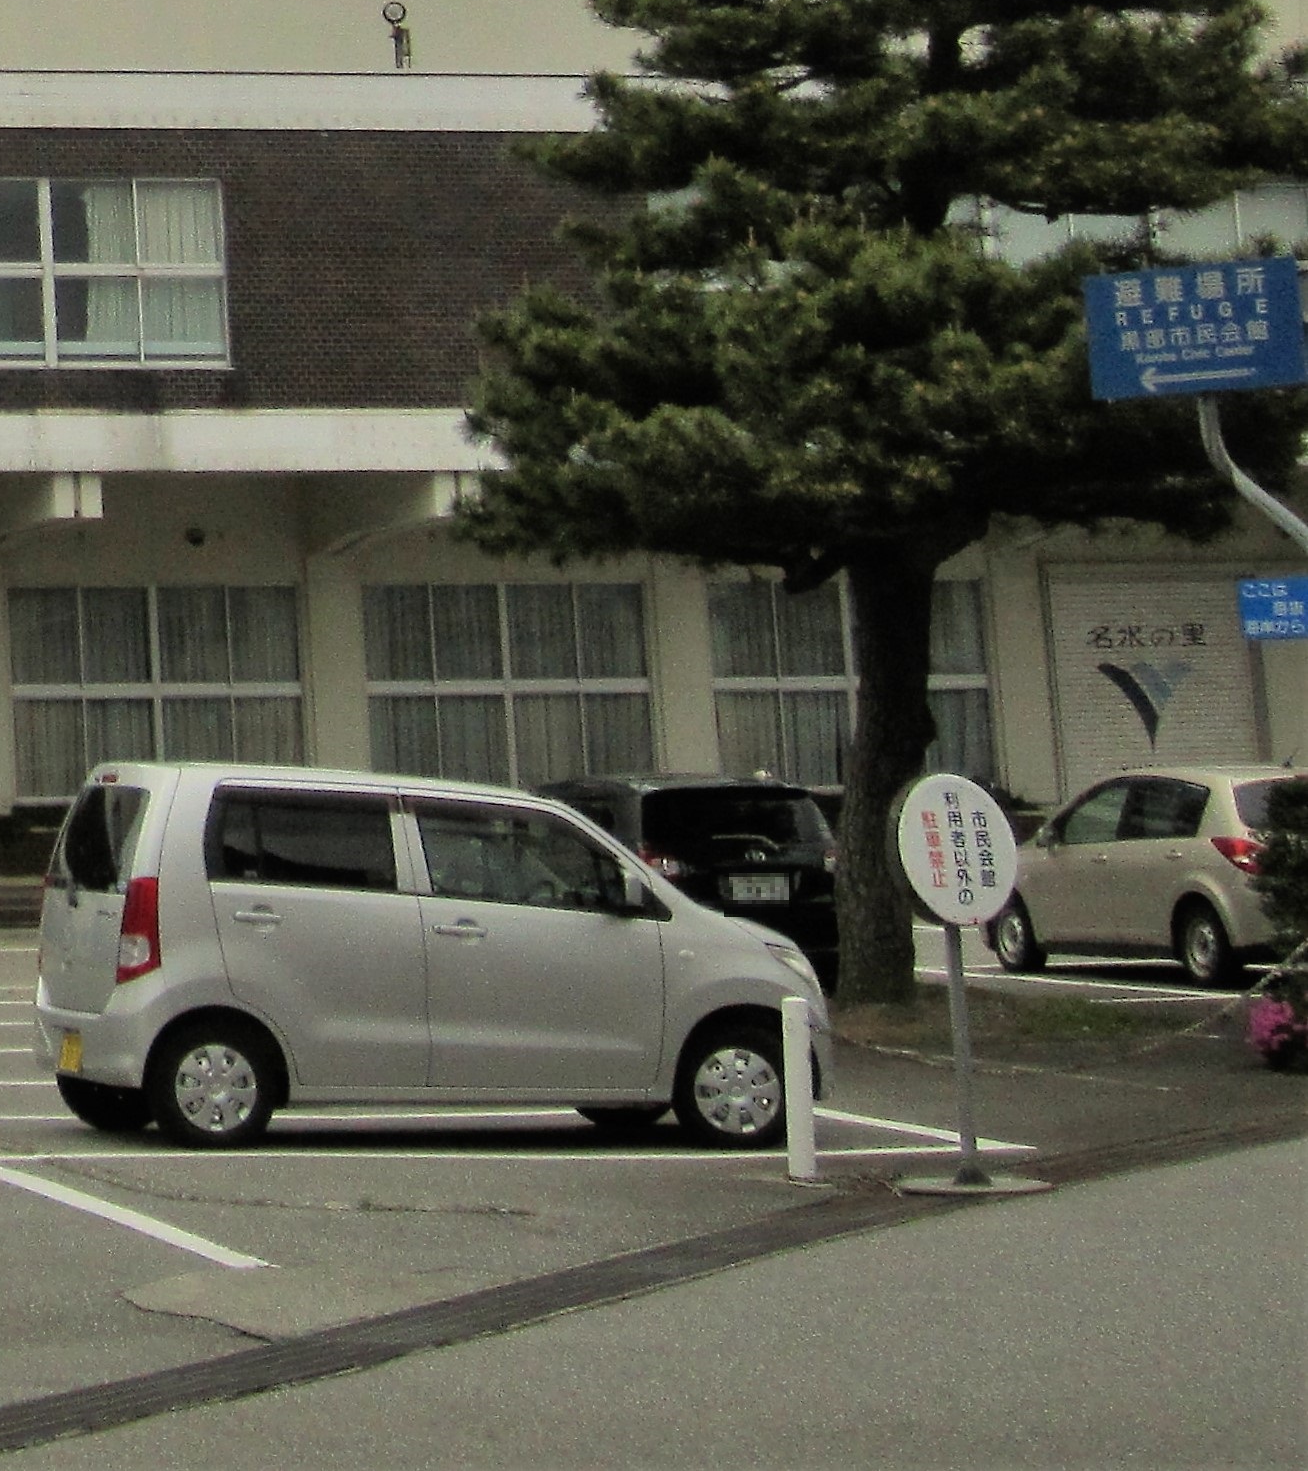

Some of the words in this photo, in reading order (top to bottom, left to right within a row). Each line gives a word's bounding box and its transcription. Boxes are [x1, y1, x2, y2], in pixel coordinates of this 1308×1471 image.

[1113, 267, 1265, 308] 避難場所
[1115, 298, 1269, 327] REFUGE
[1119, 319, 1270, 352] 黒部市民会館
[1242, 583, 1289, 598] ここは
[1086, 623, 1207, 649] 名水の里
[920, 809, 948, 889] 駐車禁止
[942, 791, 974, 906] 利用者以外の
[970, 809, 996, 888] 市民会館
